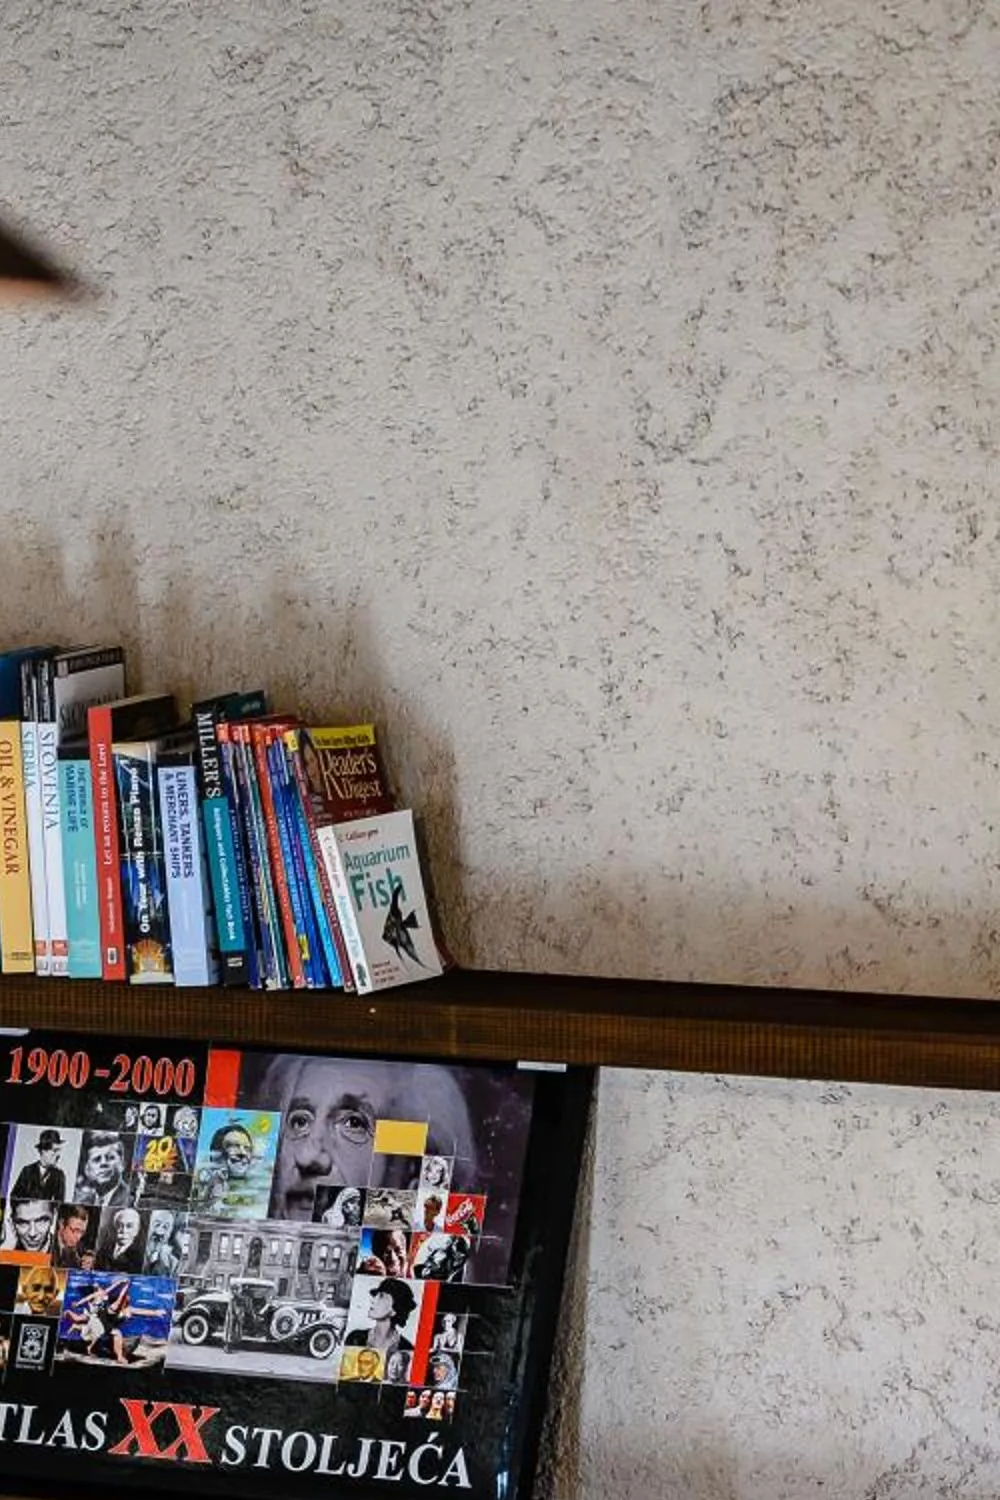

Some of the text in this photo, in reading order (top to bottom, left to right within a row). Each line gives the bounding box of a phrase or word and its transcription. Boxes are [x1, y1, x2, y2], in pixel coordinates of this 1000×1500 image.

[40, 730, 60, 829] SLOVENIA
[196, 710, 222, 799] MILLER'S
[318, 749, 378, 800] Reader's
[0, 774, 14, 787] &
[128, 766, 140, 804] Piano
[0, 792, 20, 874] VINEGAR
[165, 784, 178, 843] MERCHANT
[134, 851, 145, 879] with
[170, 846, 182, 878] SHIPS
[181, 822, 195, 877] TANKERS
[343, 843, 411, 873] Aquarium
[350, 867, 407, 912] Fish
[139, 914, 150, 932] On
[4, 1046, 197, 1097] 1900-2000
[108, 1397, 221, 1464] XX
[220, 1424, 474, 1490] STOLJEĆA
